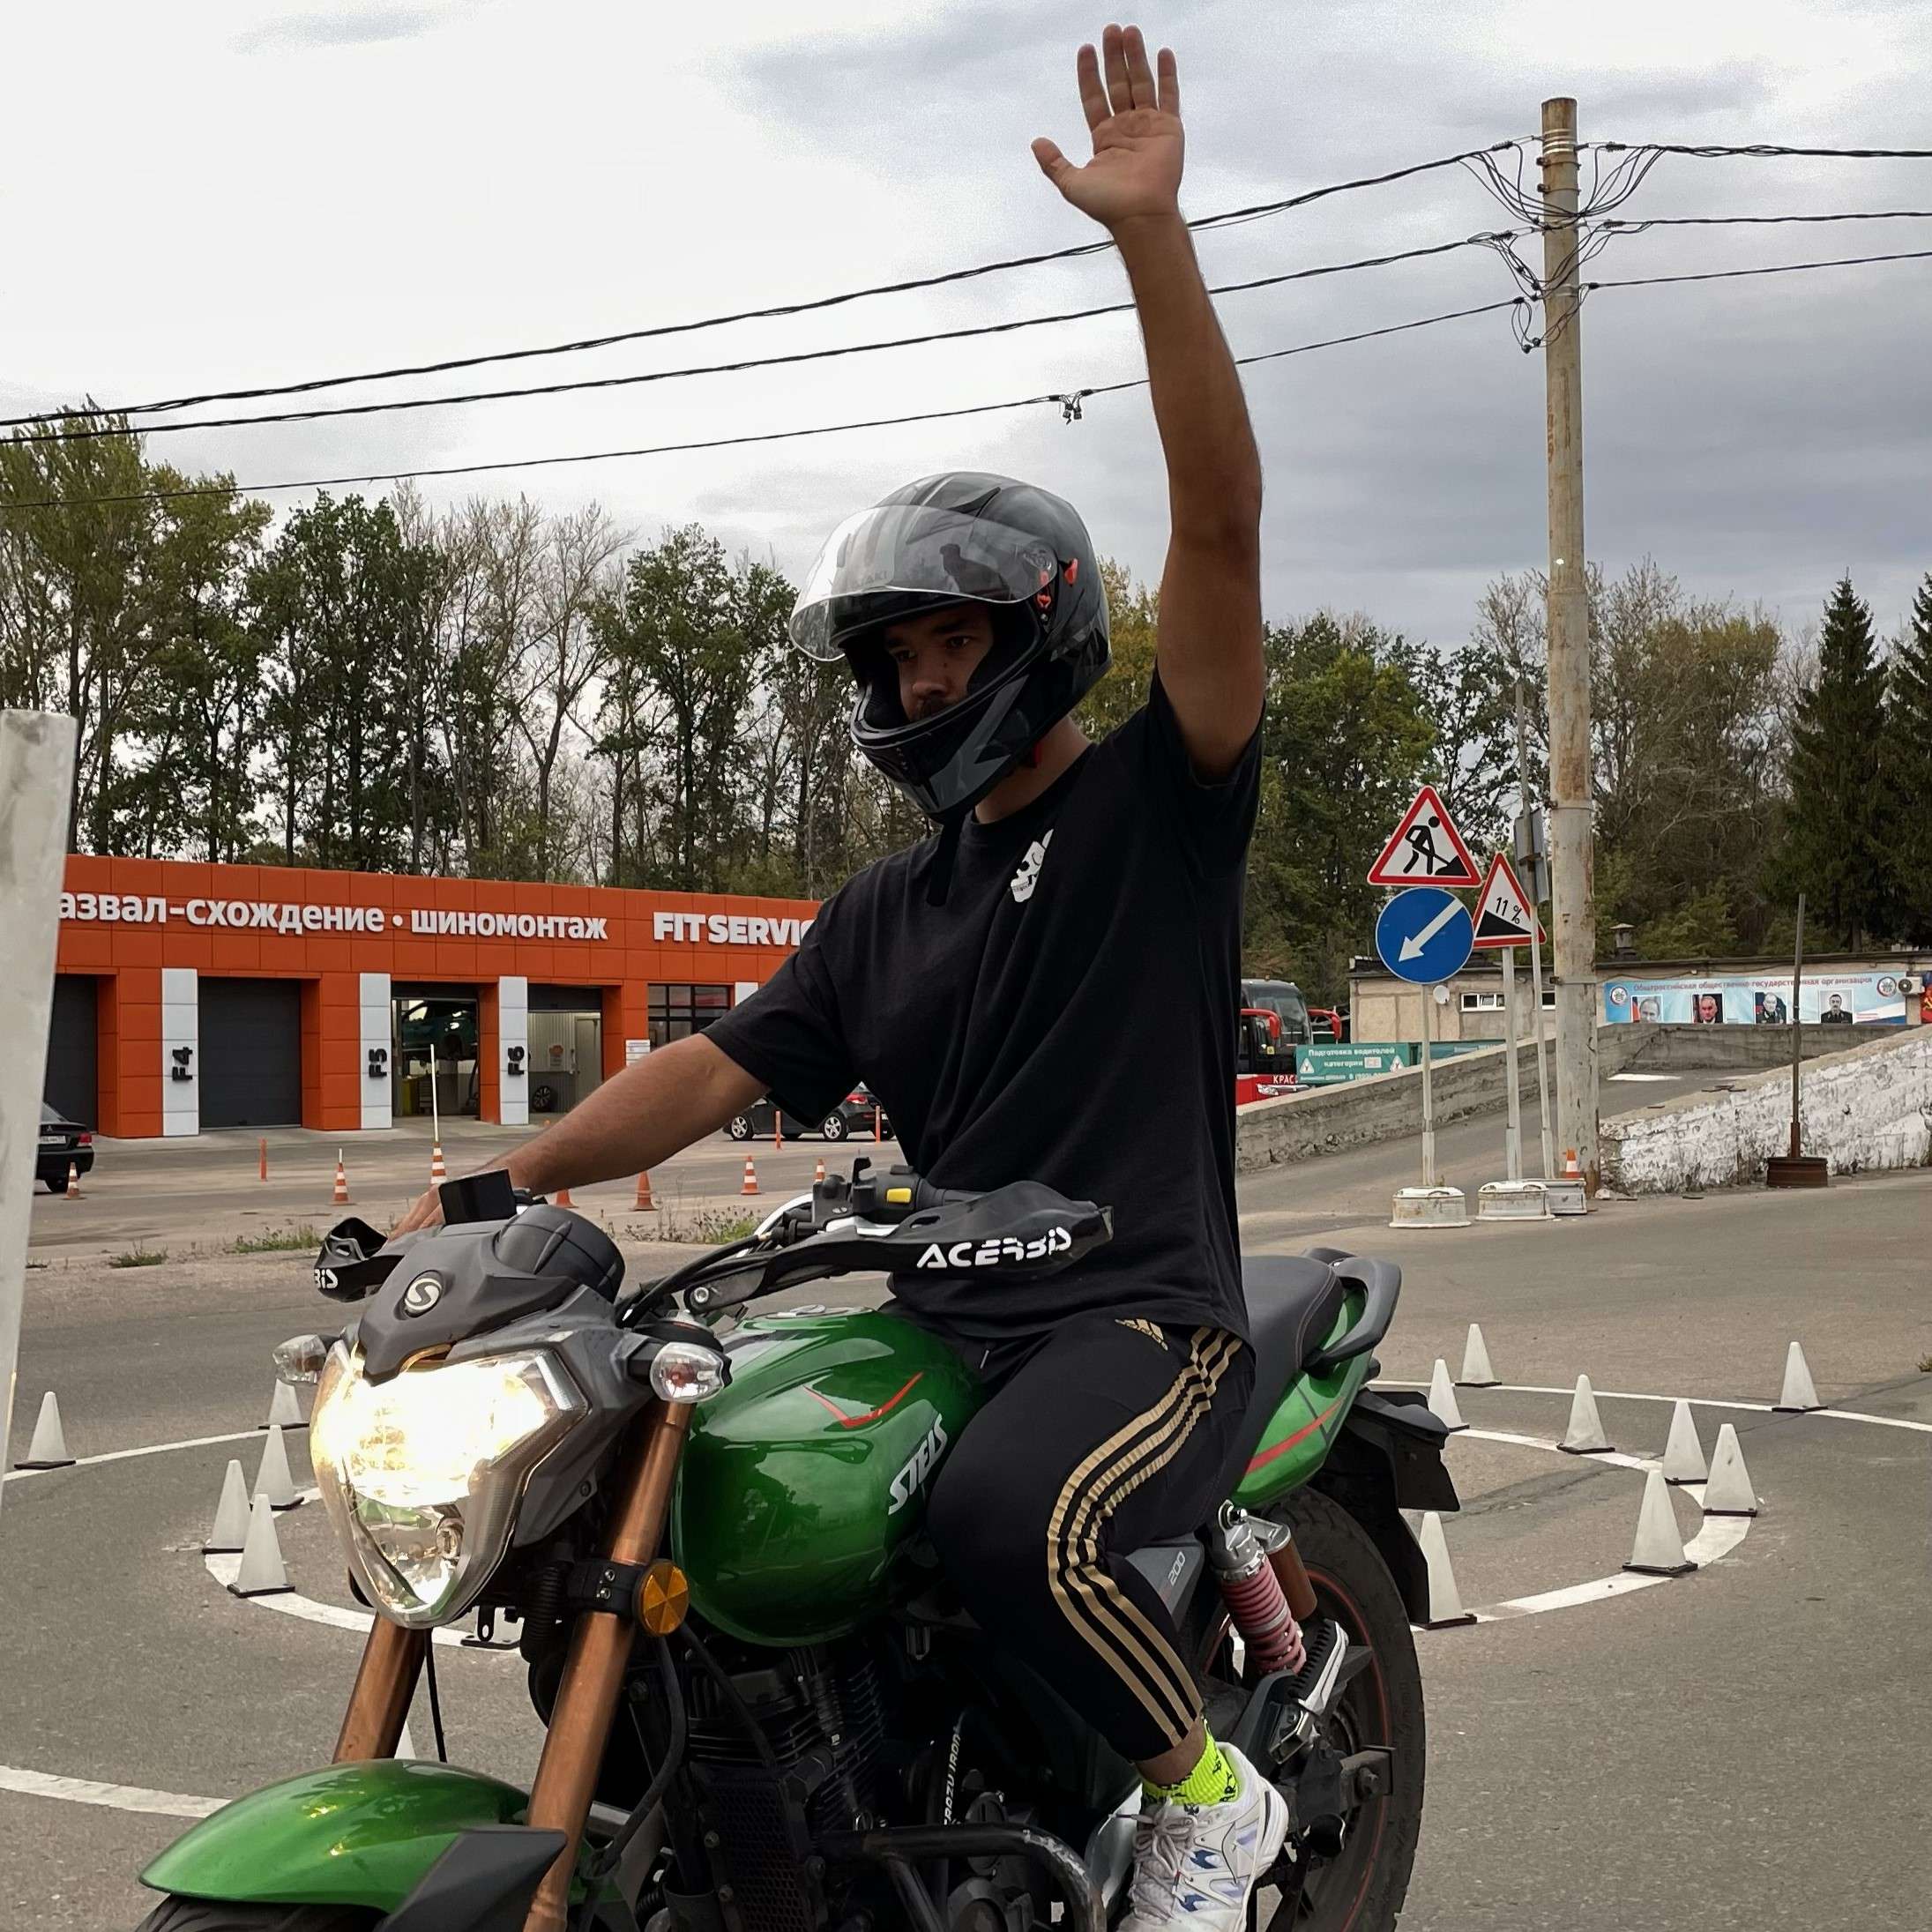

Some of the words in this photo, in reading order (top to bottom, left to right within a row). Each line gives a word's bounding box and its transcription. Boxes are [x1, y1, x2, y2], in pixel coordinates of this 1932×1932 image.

[58, 891, 384, 935] азвал-схождение
[411, 909, 608, 940] шиномонтаж
[653, 911, 706, 942] FIT
[172, 1047, 193, 1081] F4
[369, 1048, 388, 1078] F5
[507, 1046, 525, 1076] F6
[887, 1413, 948, 1516] STELS
[1167, 1551, 1186, 1586] 200
